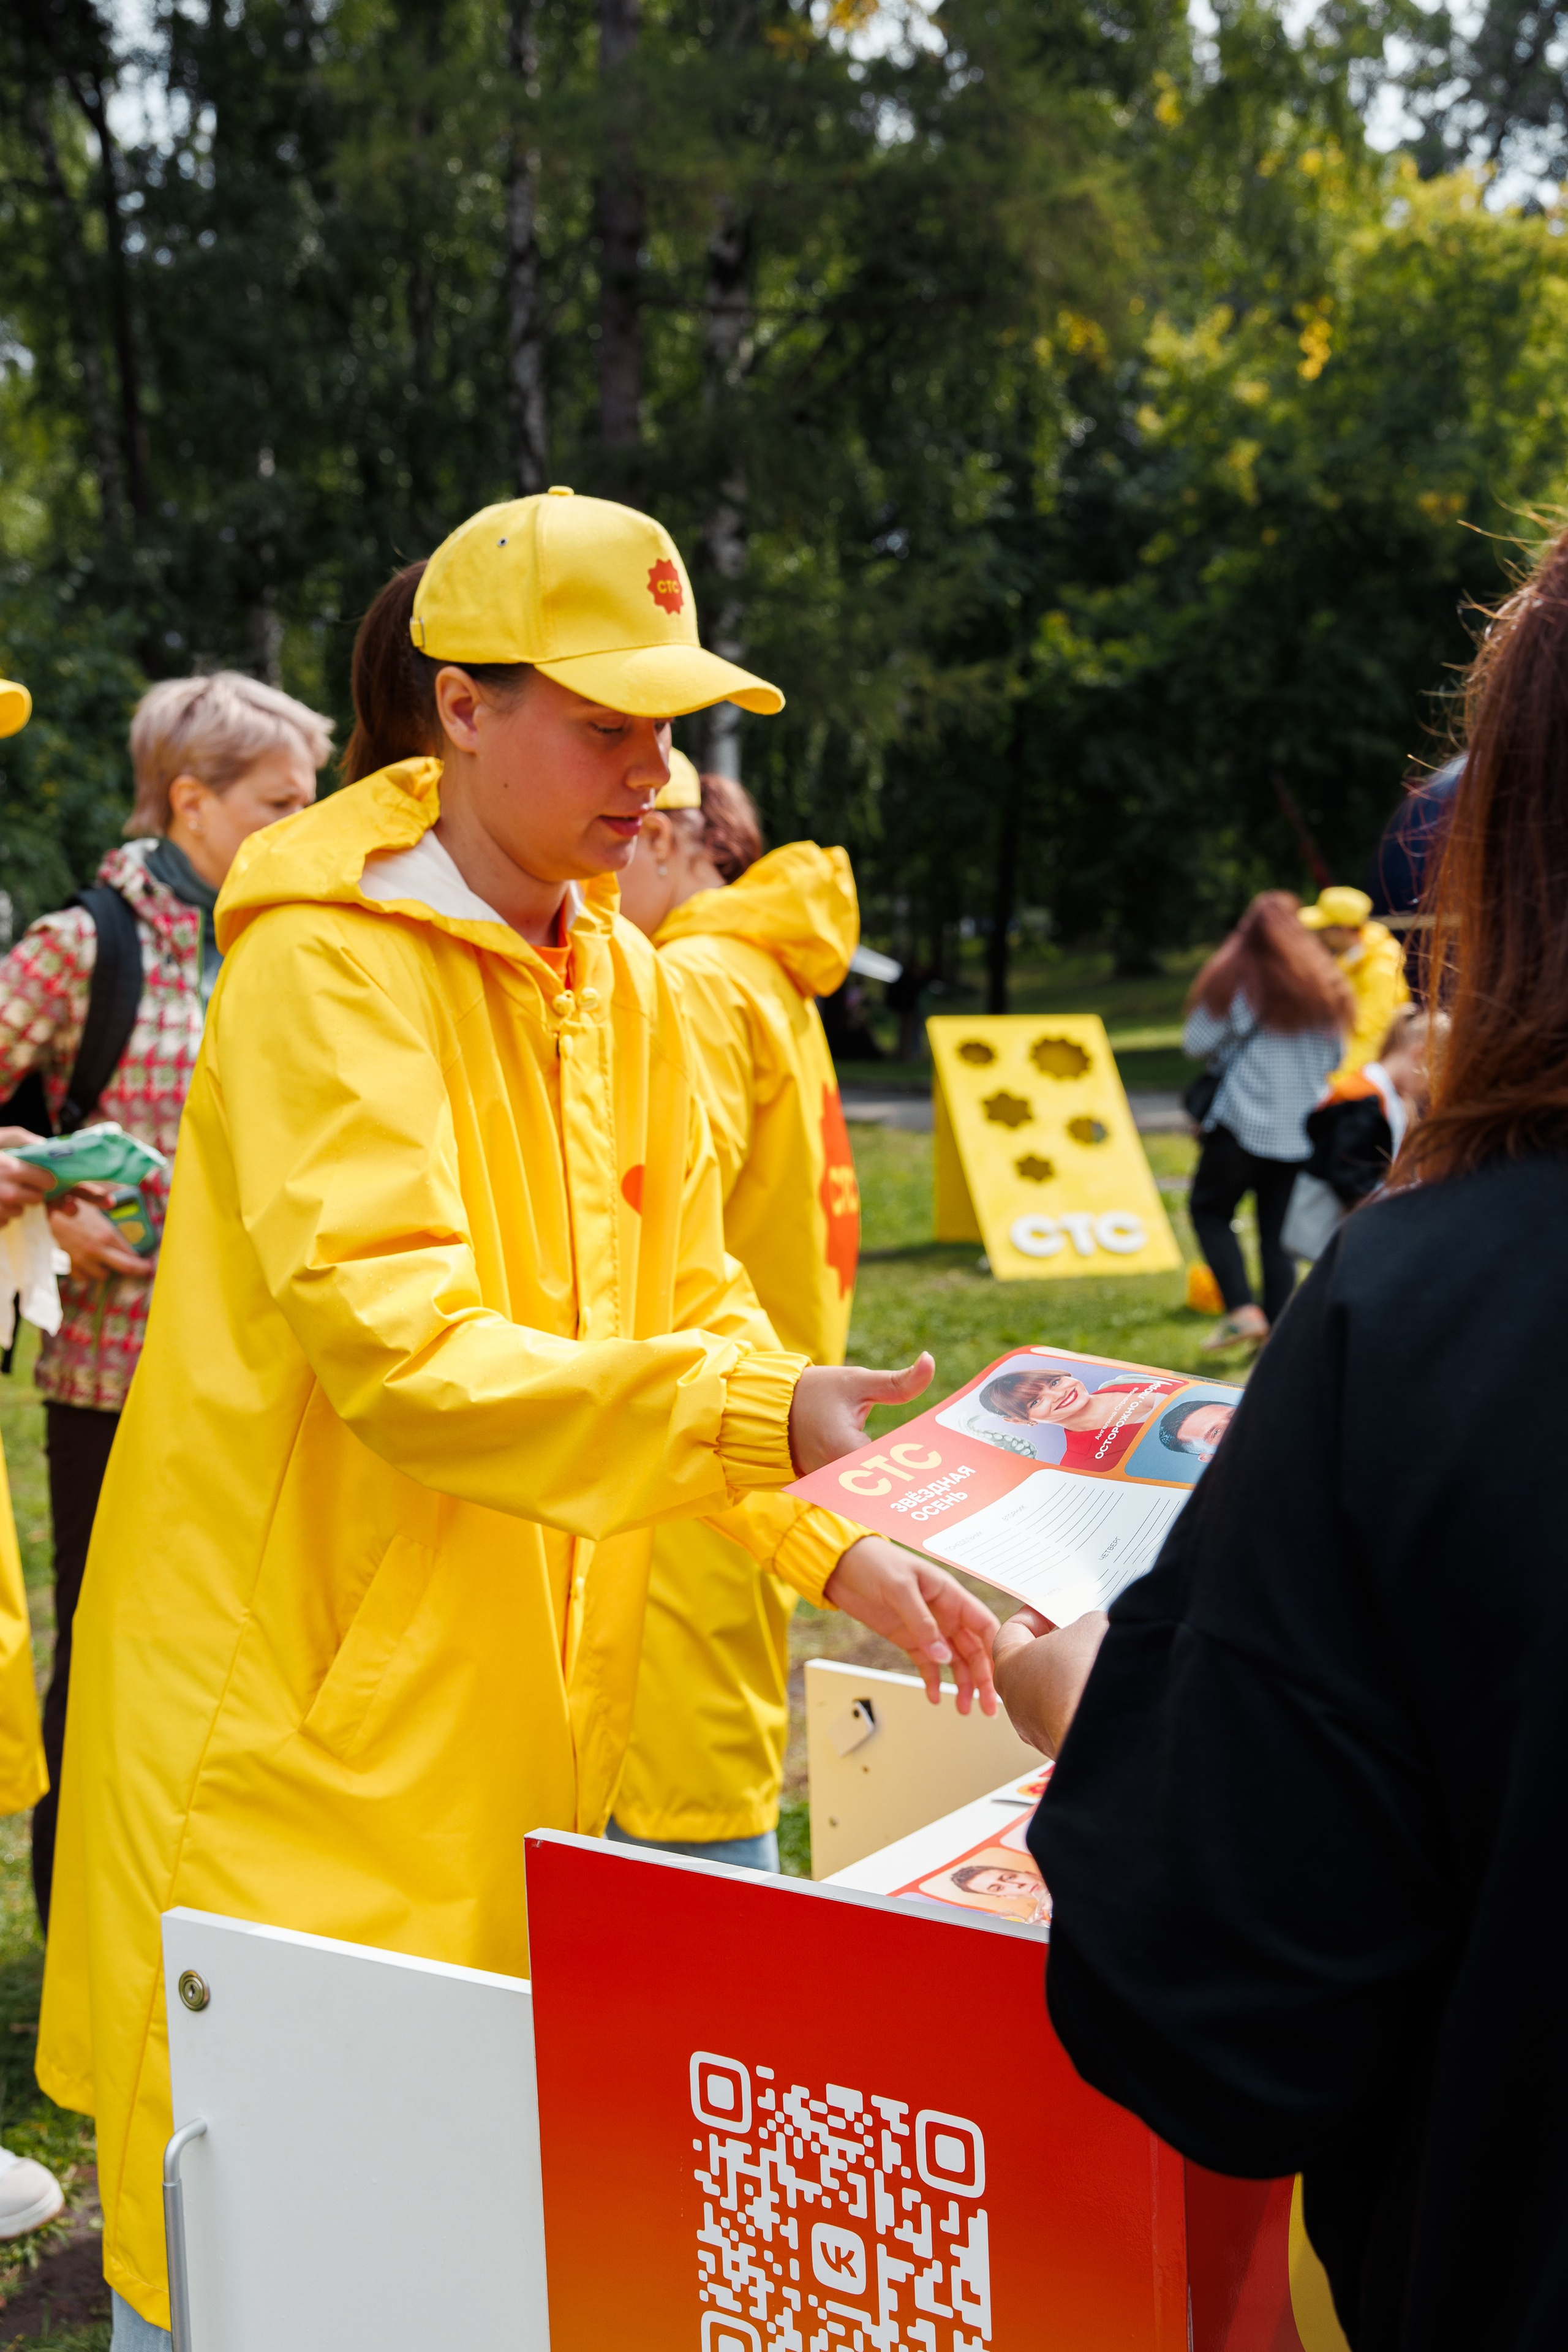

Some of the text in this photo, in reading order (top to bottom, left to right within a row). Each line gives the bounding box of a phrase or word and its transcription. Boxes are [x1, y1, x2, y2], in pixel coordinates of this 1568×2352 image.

[657, 579, 680, 594] СТС
[1010, 1210, 1147, 1257] СТС
[1095, 1411, 1118, 1440] Ангелина
[1095, 1400, 1143, 1459] ОСТОРОЖНО,
[838, 1443, 942, 1496] СТС
[890, 1464, 976, 1512] ЗВЁЗДНАЯ
[910, 1491, 968, 1521] ОСЕНЬ
[1098, 1536, 1121, 1561] ЧЕТВЕРГ
